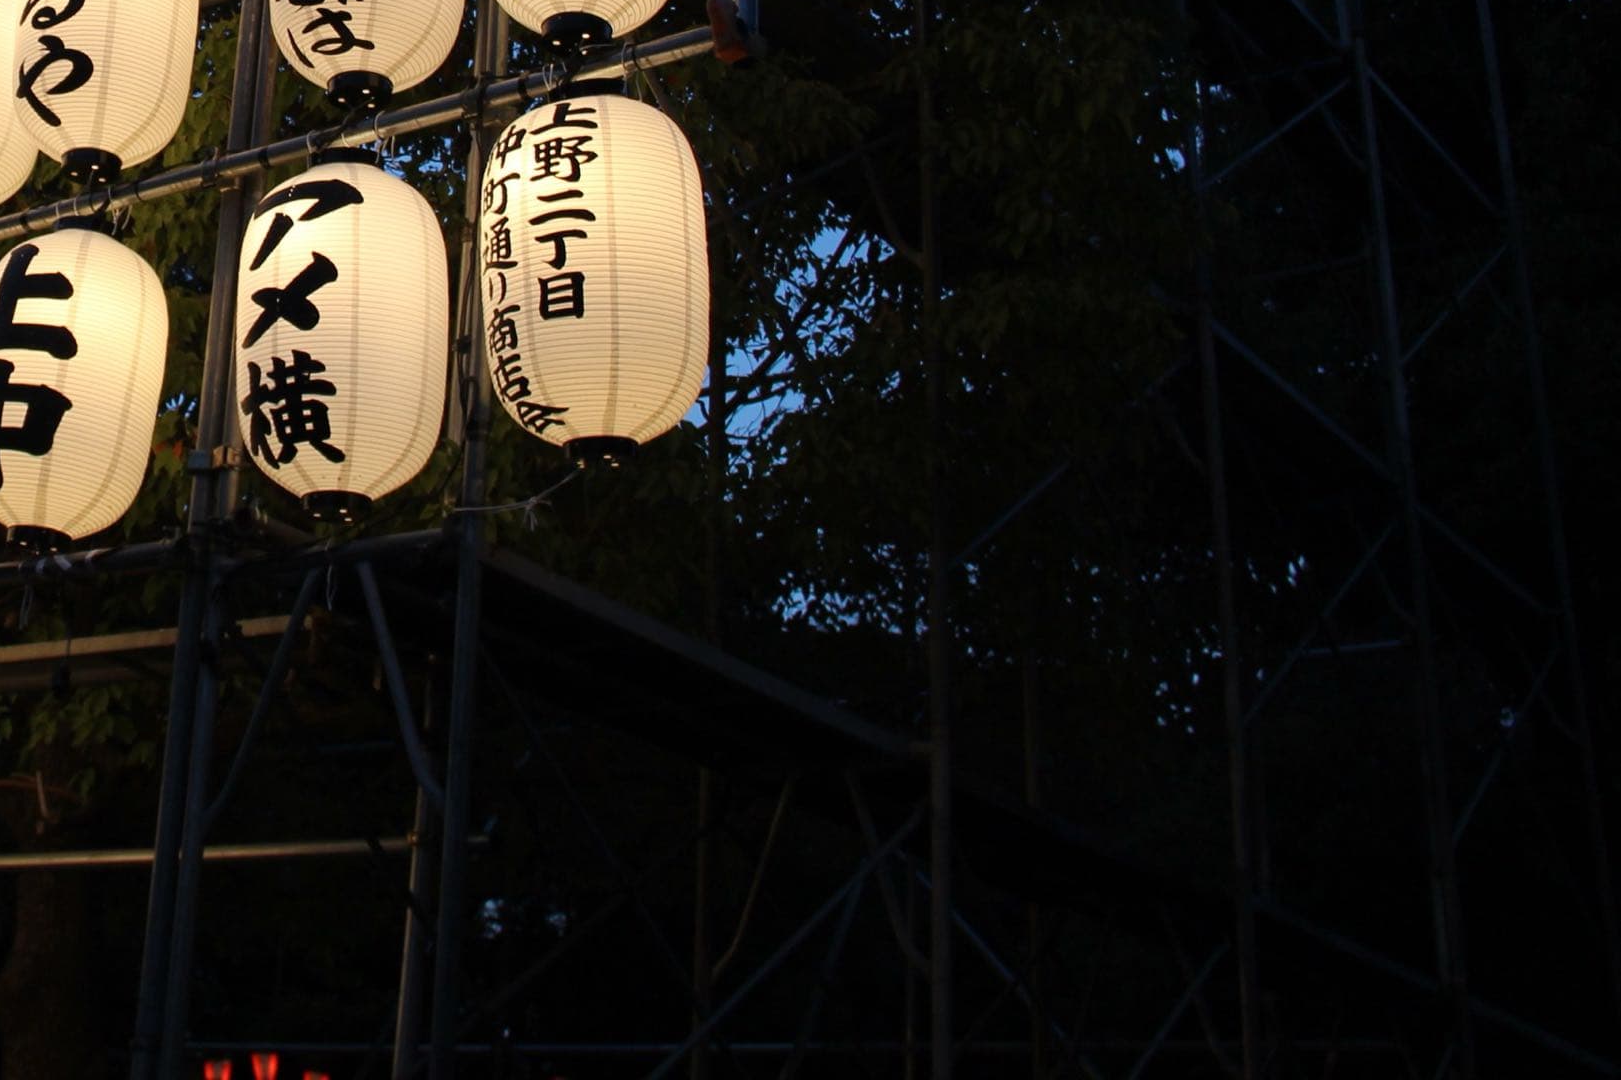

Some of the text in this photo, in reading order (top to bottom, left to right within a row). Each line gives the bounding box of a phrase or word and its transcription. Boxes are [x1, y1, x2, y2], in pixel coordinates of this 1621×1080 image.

[242, 179, 365, 469] アメ横
[481, 124, 570, 434] 仲町通り商店会
[528, 102, 599, 320] 上野二丁目
